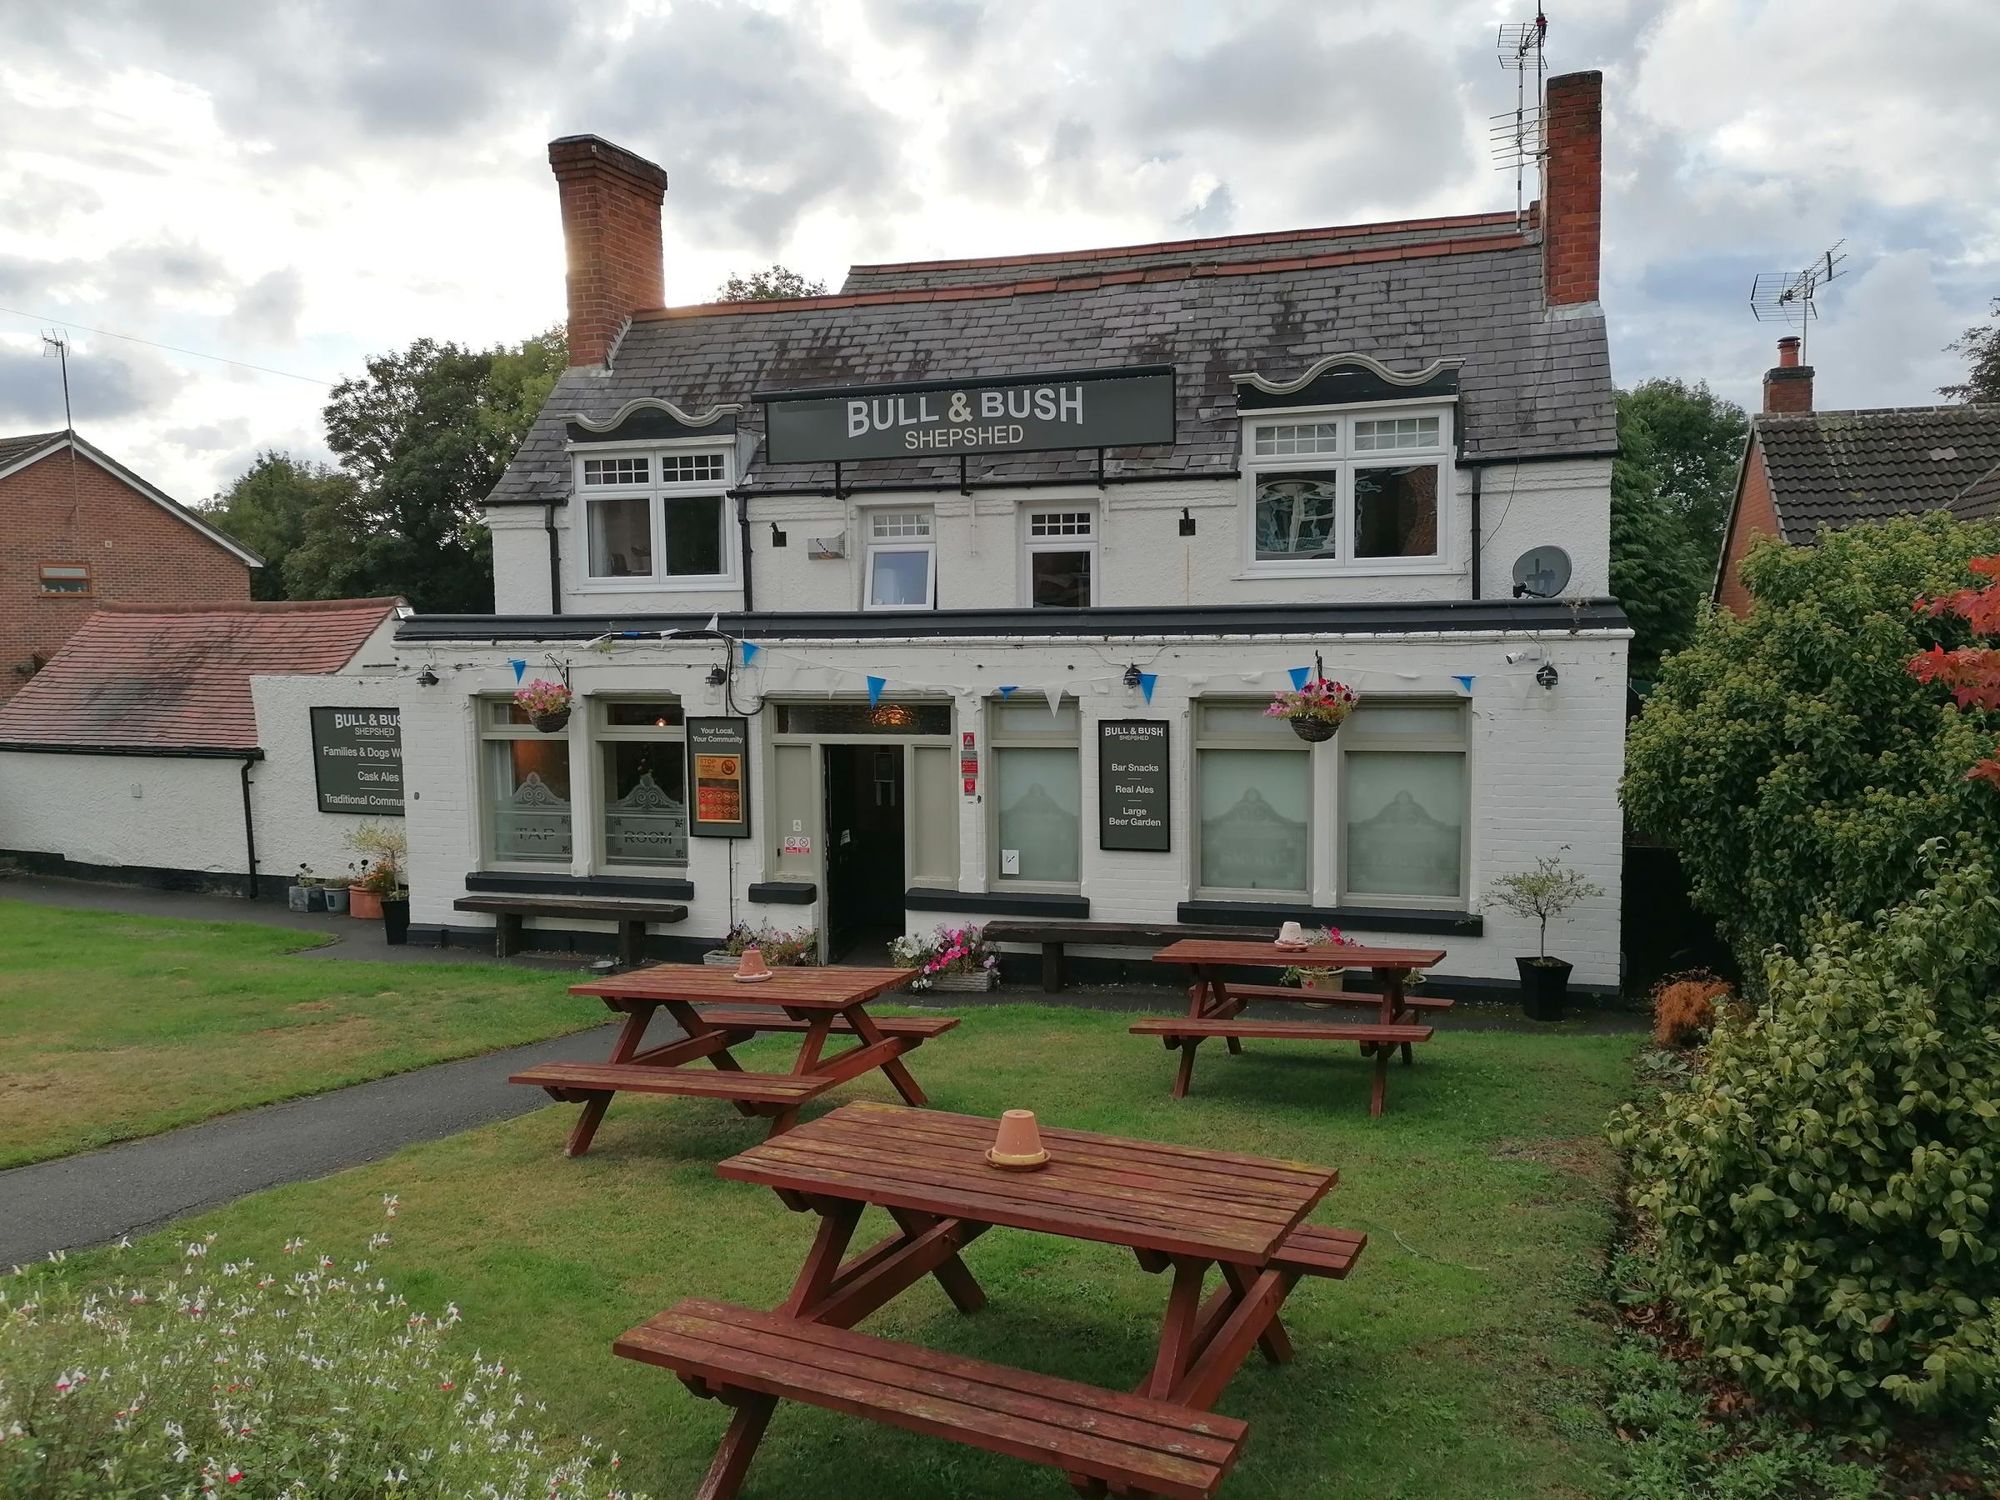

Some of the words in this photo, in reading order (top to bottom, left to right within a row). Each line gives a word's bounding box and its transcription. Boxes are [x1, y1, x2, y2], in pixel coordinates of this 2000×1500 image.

[847, 396, 940, 439] BULL
[947, 392, 974, 424] &
[980, 386, 1084, 425] BUSH
[904, 424, 1024, 450] SHEPSHED
[334, 713, 367, 729] BULL
[368, 713, 378, 726] &
[354, 727, 395, 737] SHEPSHED
[715, 727, 735, 735] Local,
[1105, 727, 1129, 737] BULL
[1130, 727, 1137, 735] &
[1138, 727, 1164, 737] BUSH
[707, 735, 743, 745] Community
[323, 746, 358, 757] Families
[359, 747, 366, 757] &
[367, 747, 390, 760] Dogs
[1111, 763, 1127, 772] Bar
[1128, 763, 1159, 772] Snacks
[357, 771, 380, 781] Cask
[380, 772, 400, 782] Ales
[1115, 785, 1134, 794] Real
[1135, 785, 1155, 794] Ales
[324, 793, 368, 805] Traditional
[1122, 807, 1147, 817] Large
[1109, 817, 1129, 826] Beer
[1130, 817, 1161, 826] Garden
[516, 827, 556, 841] TAP
[624, 830, 672, 845] ROOM
